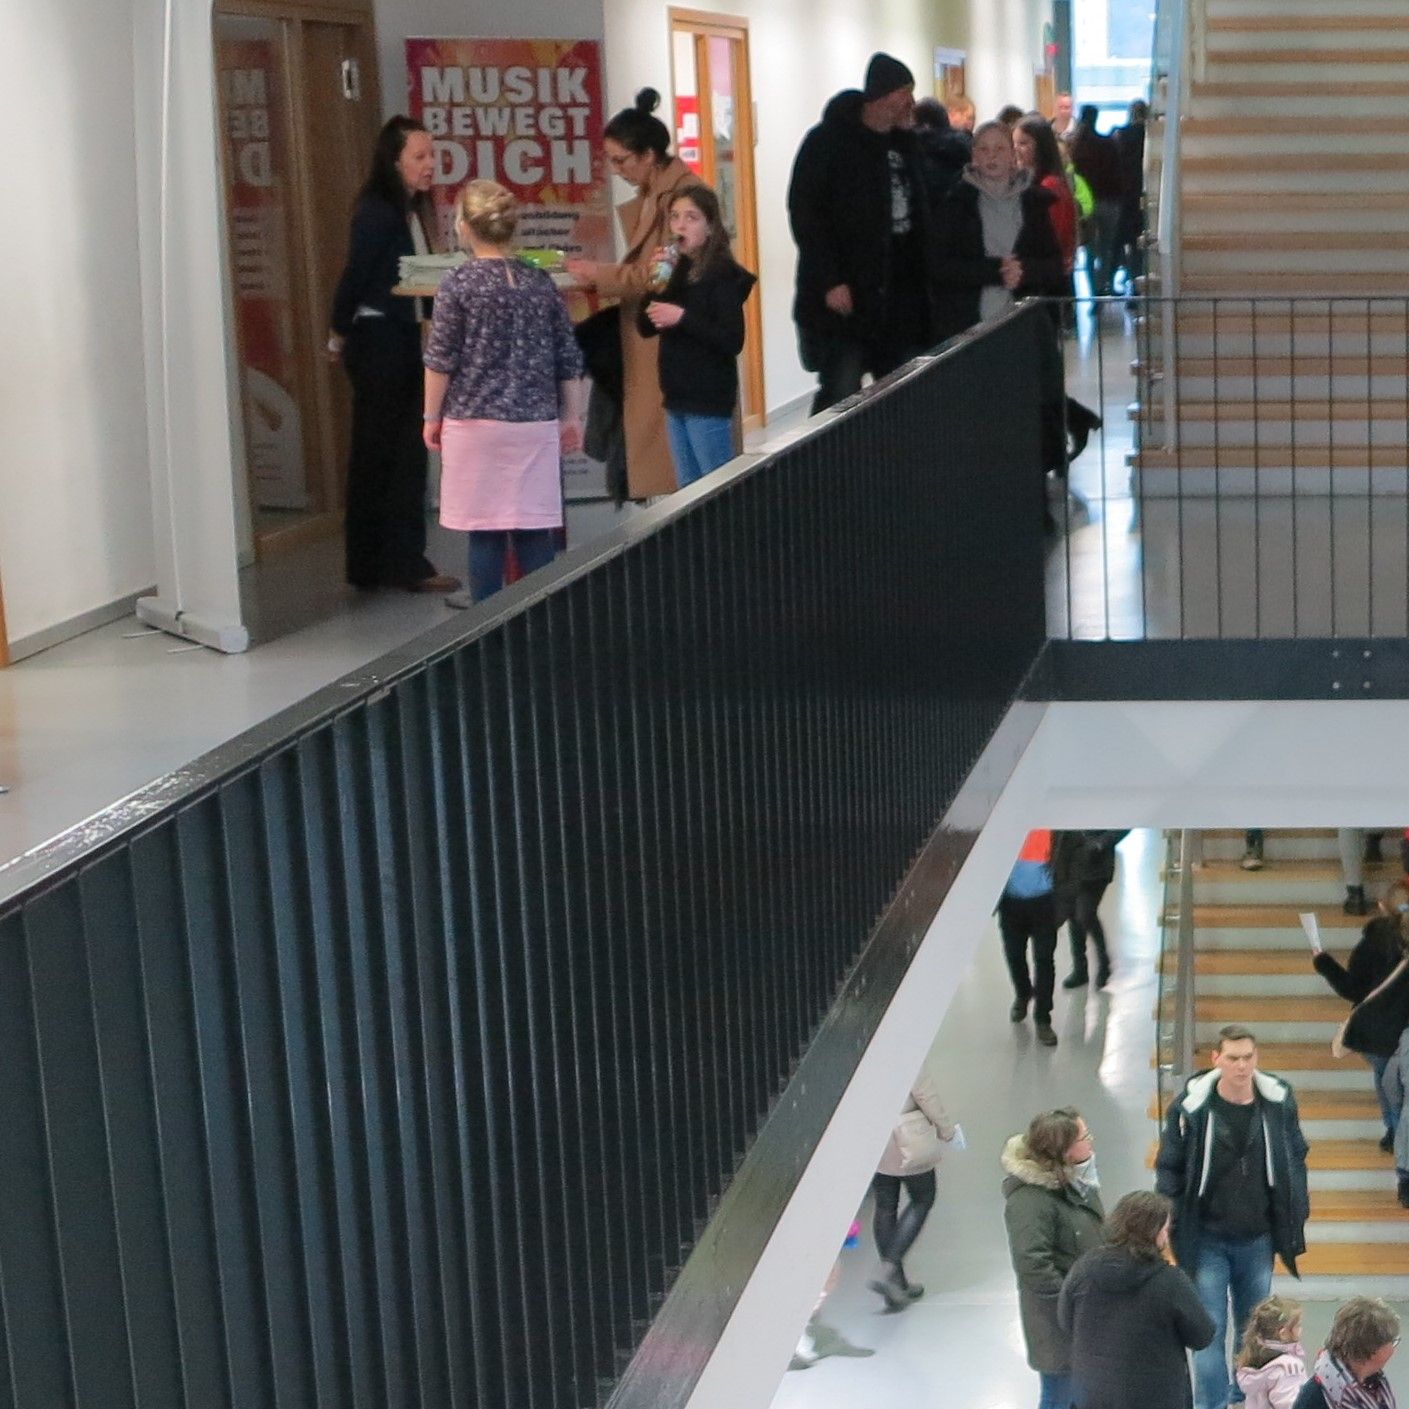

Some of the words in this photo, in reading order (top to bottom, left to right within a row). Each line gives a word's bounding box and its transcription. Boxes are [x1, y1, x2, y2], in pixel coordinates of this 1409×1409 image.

[421, 66, 590, 104] MUSIK
[422, 106, 590, 136] BEWEGT
[431, 139, 592, 185] DICH
